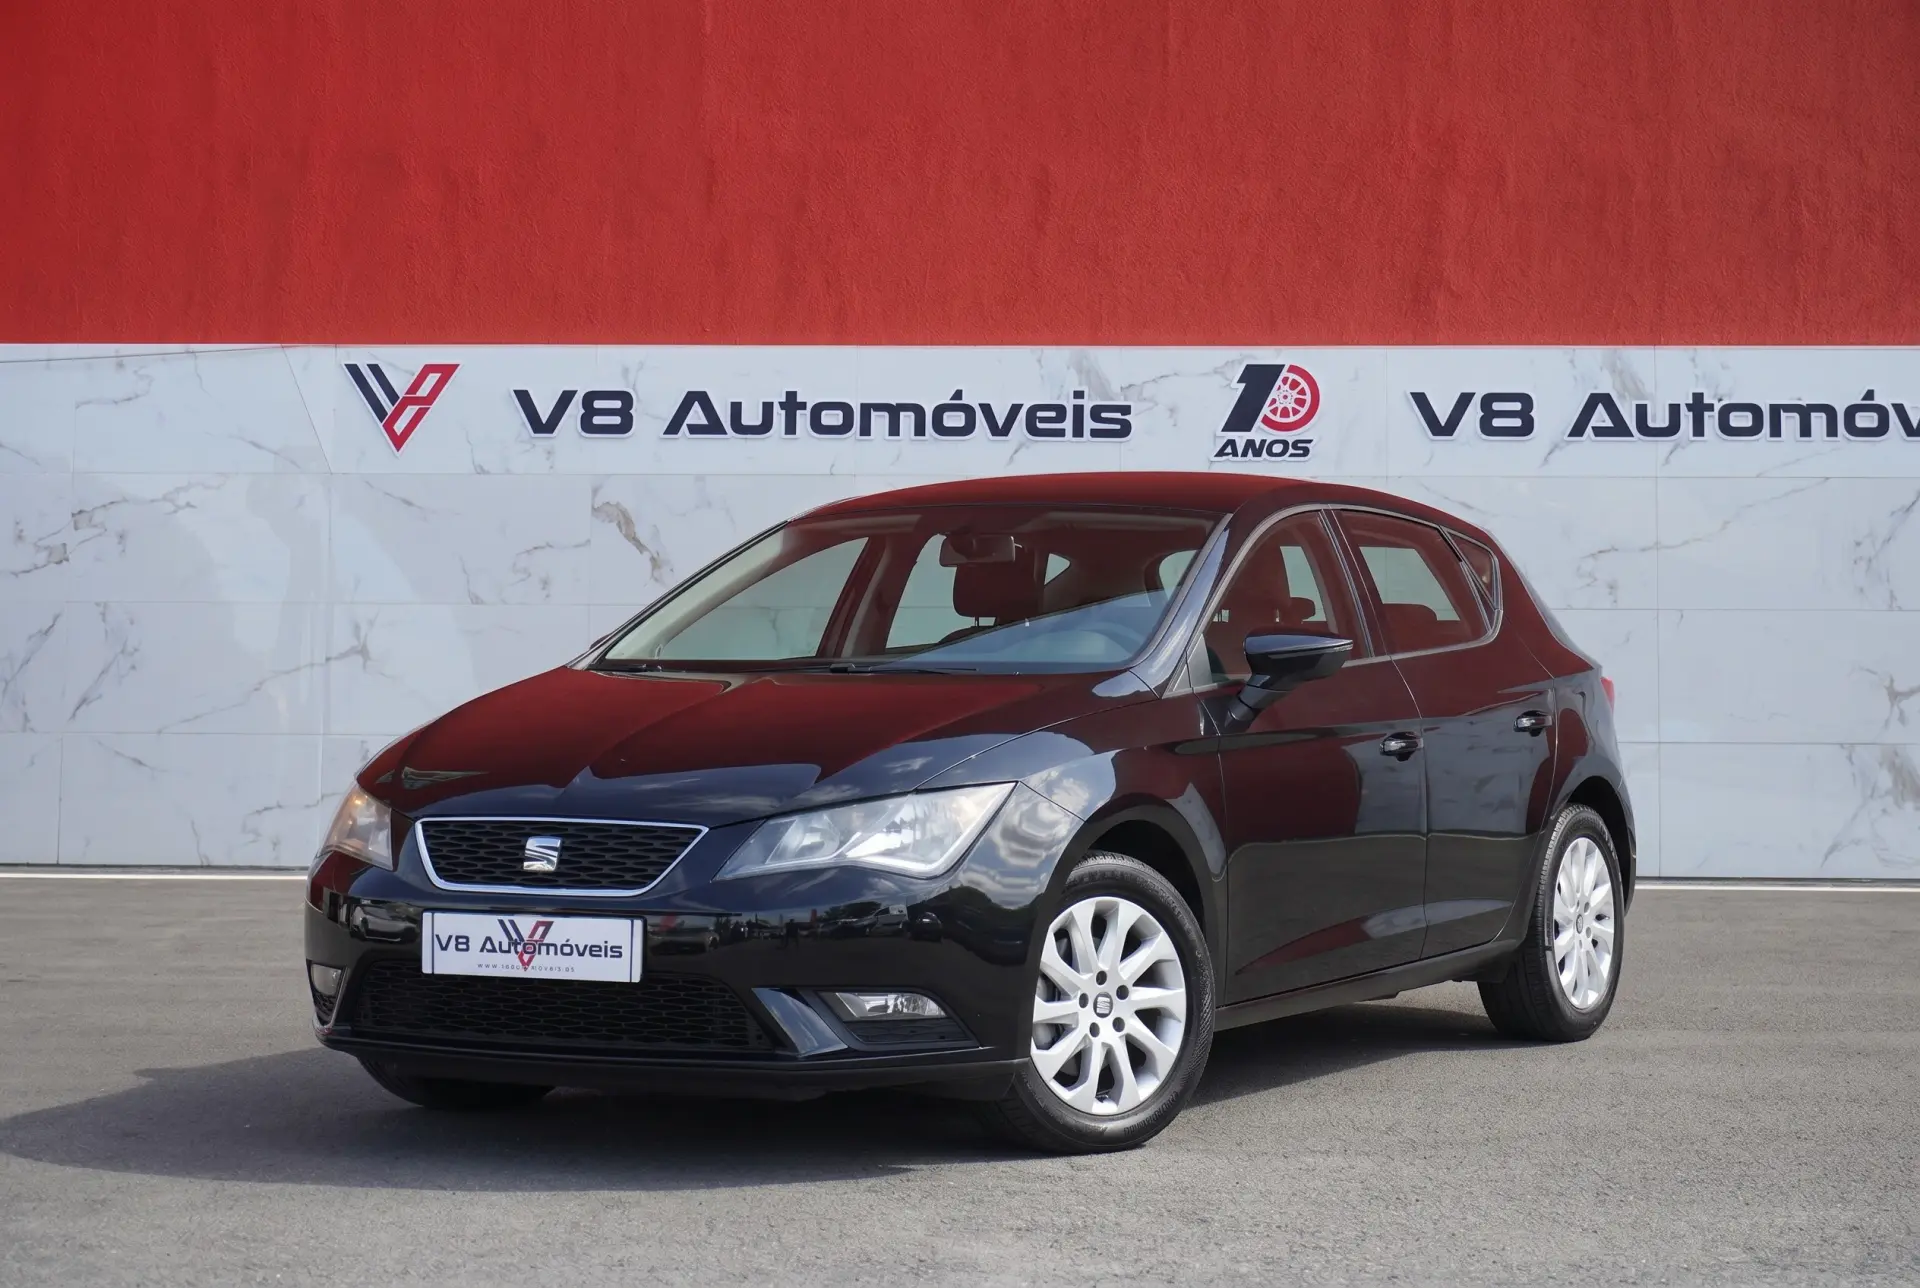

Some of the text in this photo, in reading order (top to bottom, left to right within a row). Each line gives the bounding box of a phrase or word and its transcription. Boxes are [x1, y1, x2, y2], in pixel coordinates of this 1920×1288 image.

[513, 389, 1132, 438] V8 Automóveis
[1409, 389, 1920, 438] V8 Automóv
[1213, 438, 1314, 458] ANOS
[435, 933, 623, 959] V8 Automóveis
